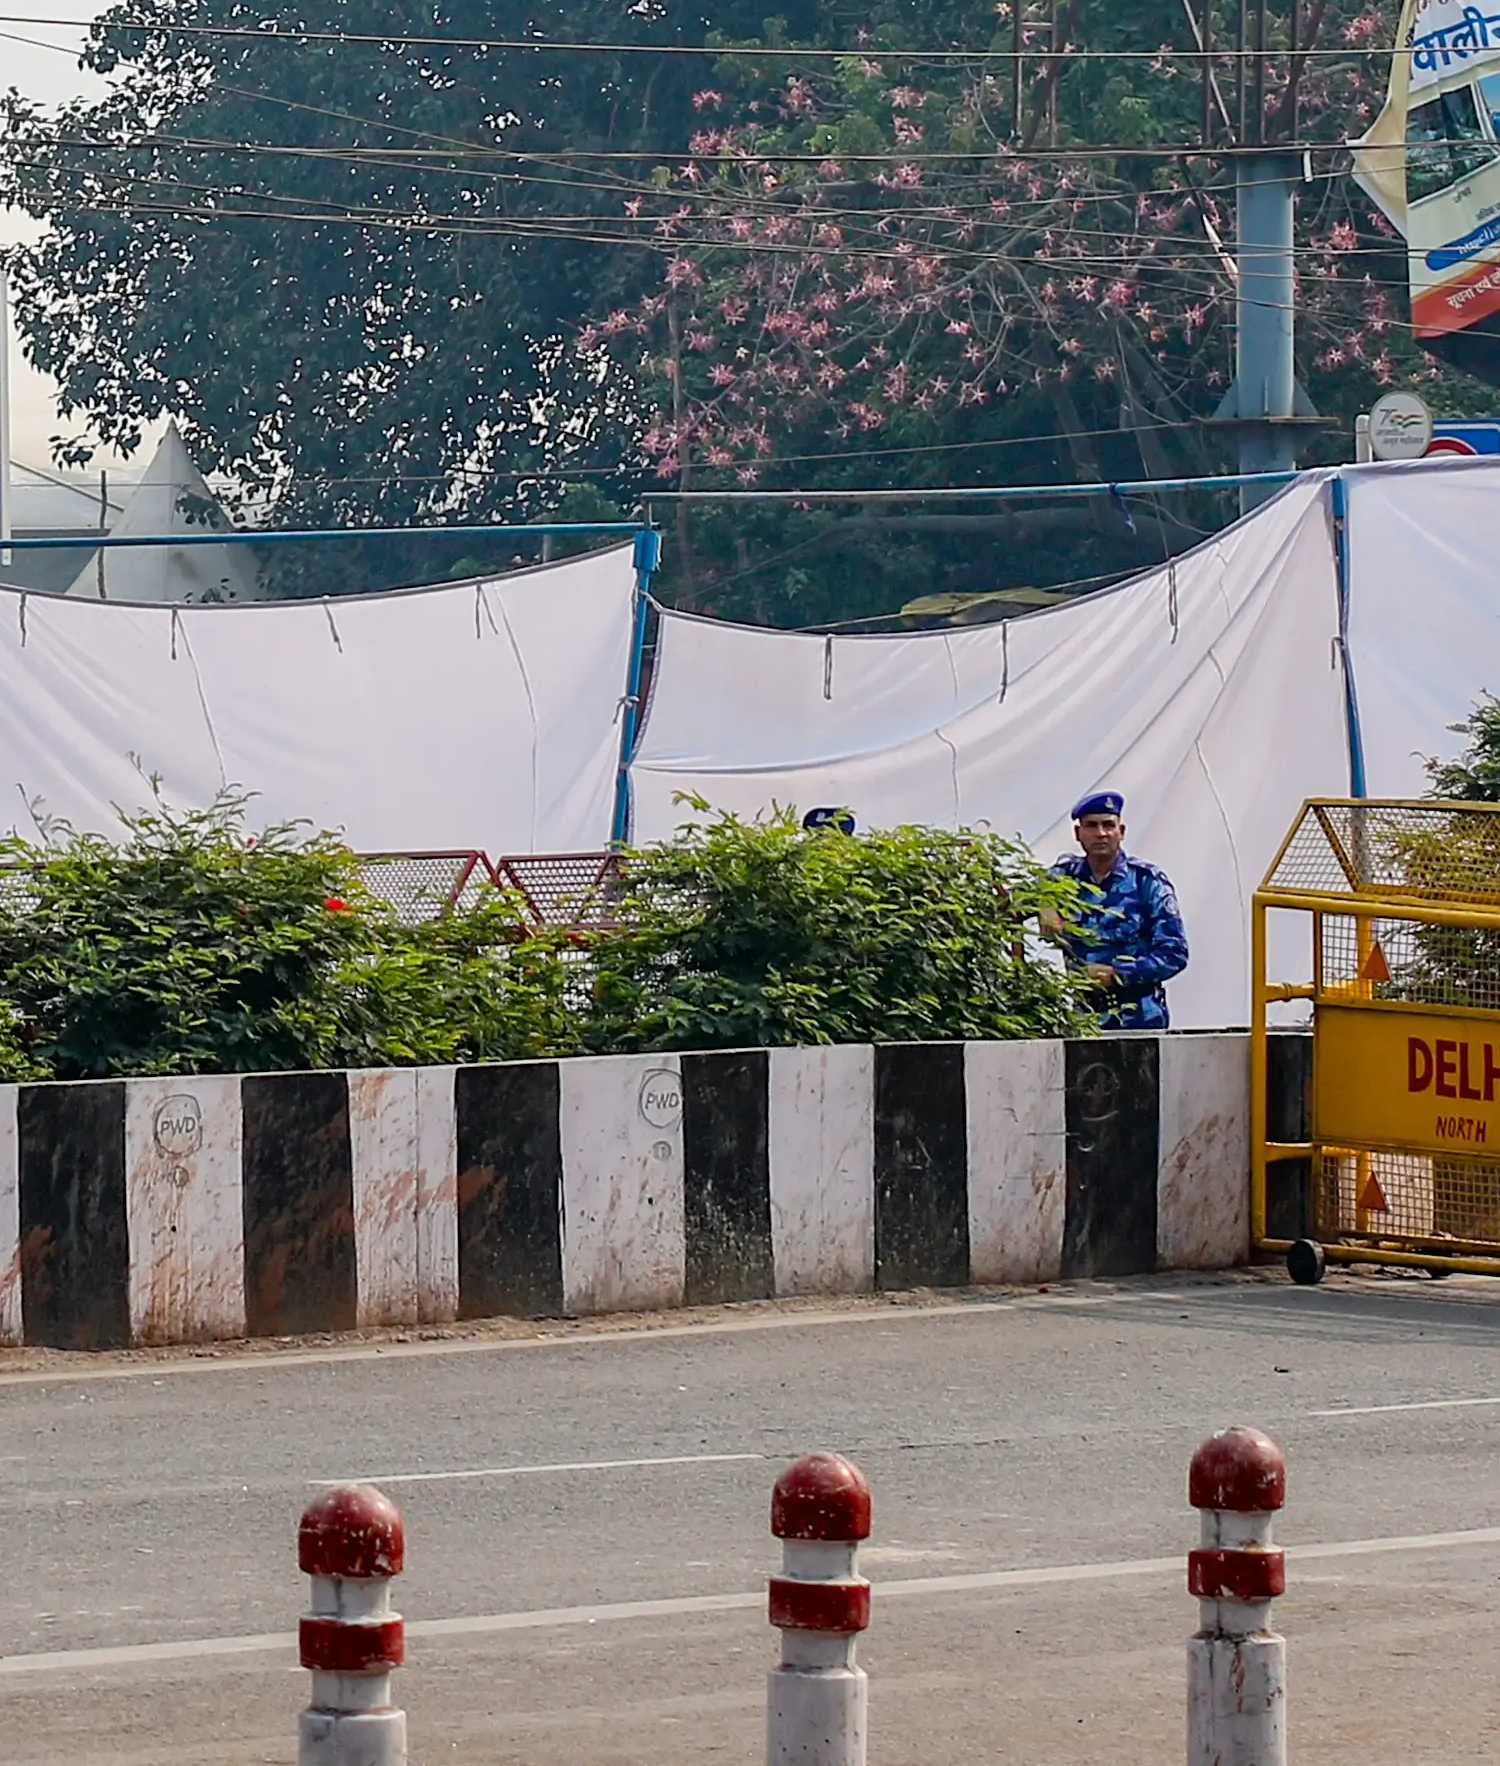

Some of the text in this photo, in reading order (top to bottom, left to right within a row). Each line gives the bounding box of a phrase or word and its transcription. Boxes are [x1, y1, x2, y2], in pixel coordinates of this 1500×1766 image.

[644, 1091, 680, 1110] PWD
[160, 1115, 197, 1137] PWD
[1435, 1115, 1487, 1143] NORTH
